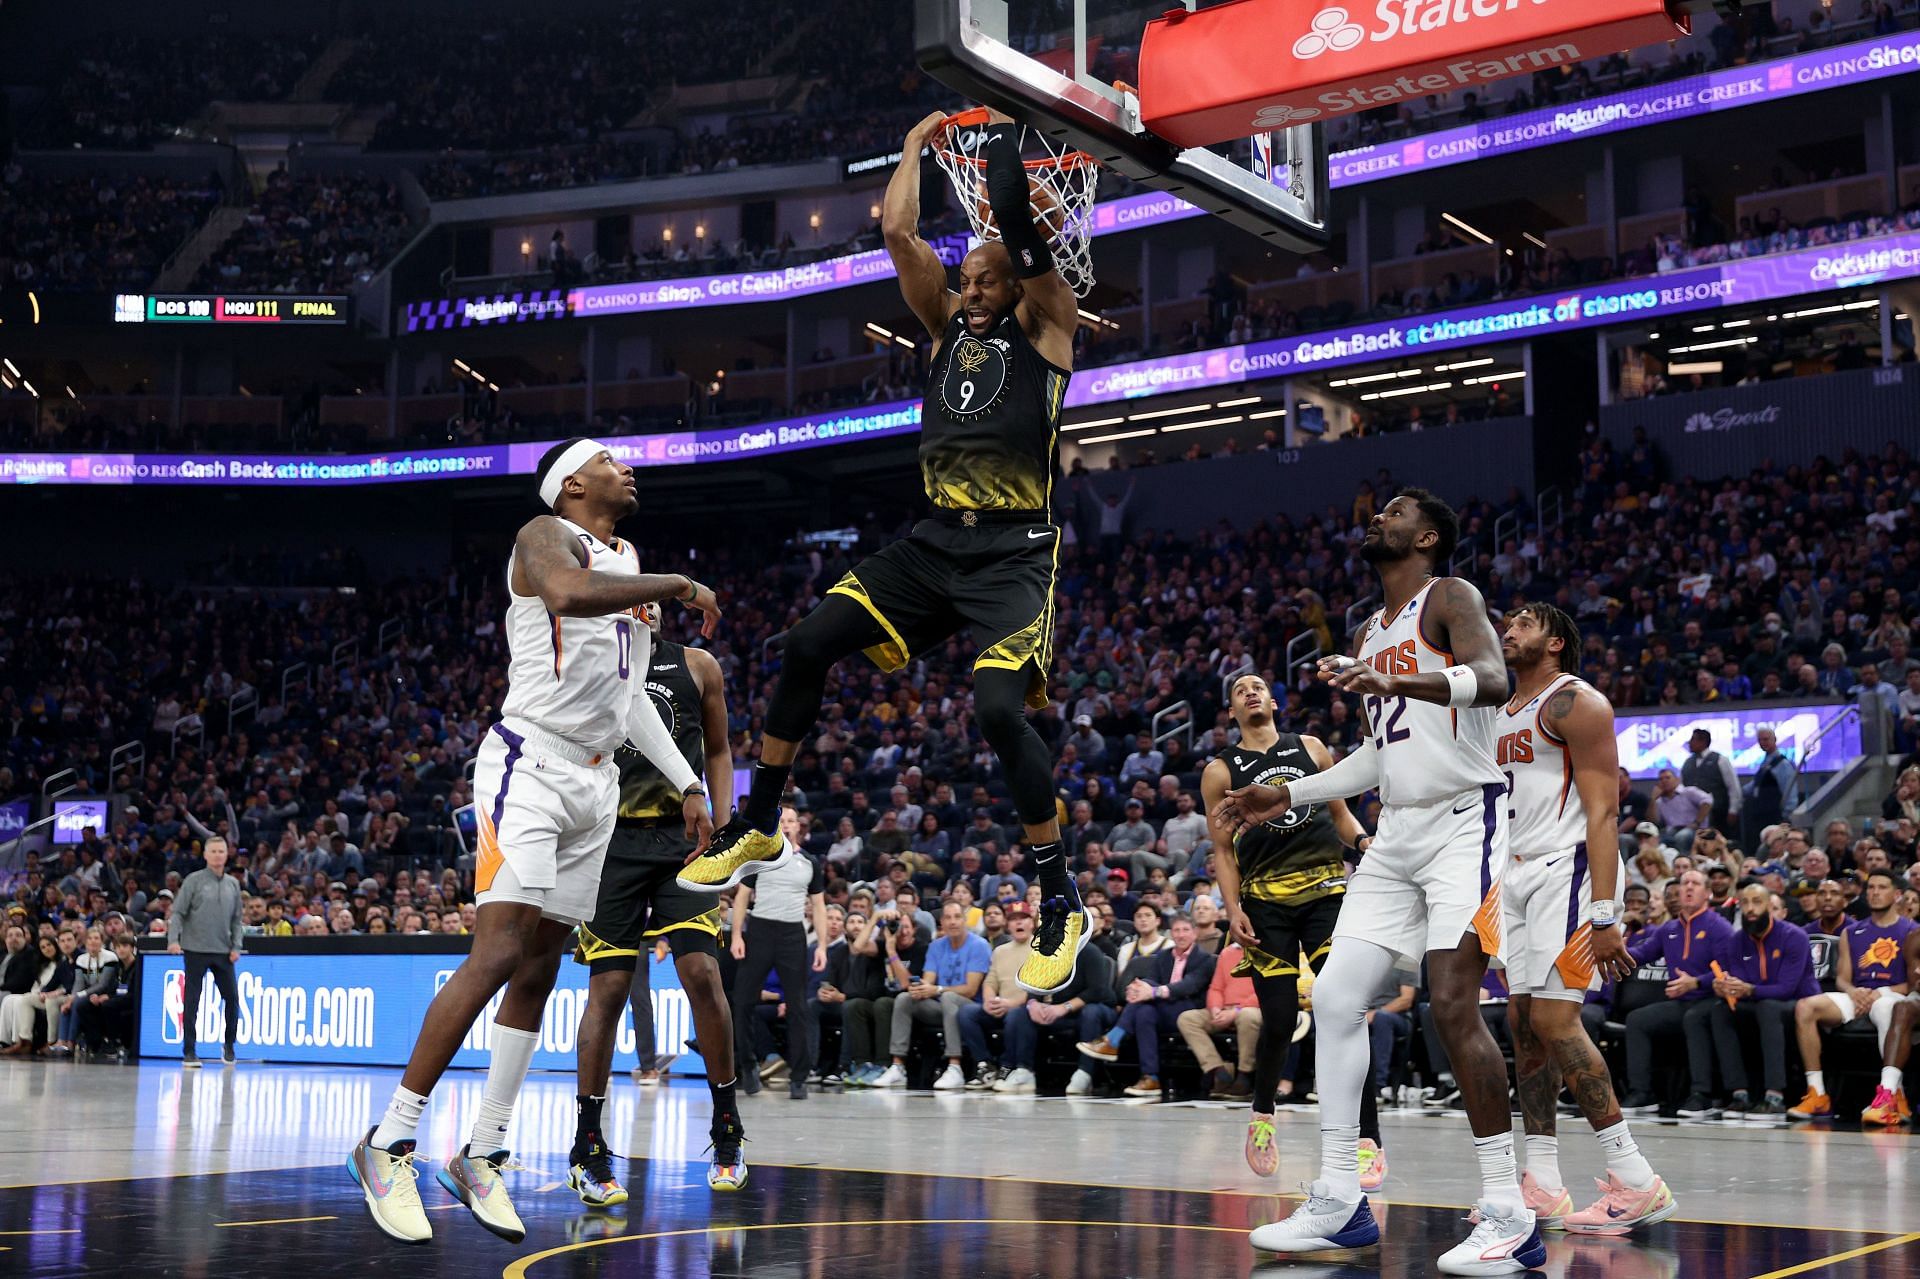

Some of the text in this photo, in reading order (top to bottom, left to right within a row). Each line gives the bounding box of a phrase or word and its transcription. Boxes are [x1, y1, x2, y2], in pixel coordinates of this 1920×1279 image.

[1797, 55, 1870, 83] CASINO
[1627, 78, 1764, 119] CACHE CREEK
[1555, 103, 1627, 132] Rakuten
[1427, 134, 1490, 159] CASINO
[1344, 153, 1400, 176] CREEK
[1117, 200, 1169, 222] CASINO
[852, 259, 897, 278] CASIN
[708, 278, 740, 296] Get
[1661, 279, 1736, 305] RESORT
[156, 301, 187, 314] BOS
[225, 301, 277, 316] HOU 111
[293, 302, 336, 315] FINAL
[586, 291, 640, 309] CASINO
[1298, 337, 1347, 363] Cash
[1351, 327, 1402, 354] Back
[1554, 297, 1578, 322] of
[1229, 351, 1290, 373] CASINO
[960, 381, 974, 409] 9
[1712, 405, 1780, 431] Sports
[778, 422, 816, 444] Back
[668, 440, 722, 458] CASINO
[92, 463, 149, 478] CASINO
[230, 461, 275, 478] Back
[616, 620, 630, 680] 0
[1251, 766, 1306, 785] ARRIORS
